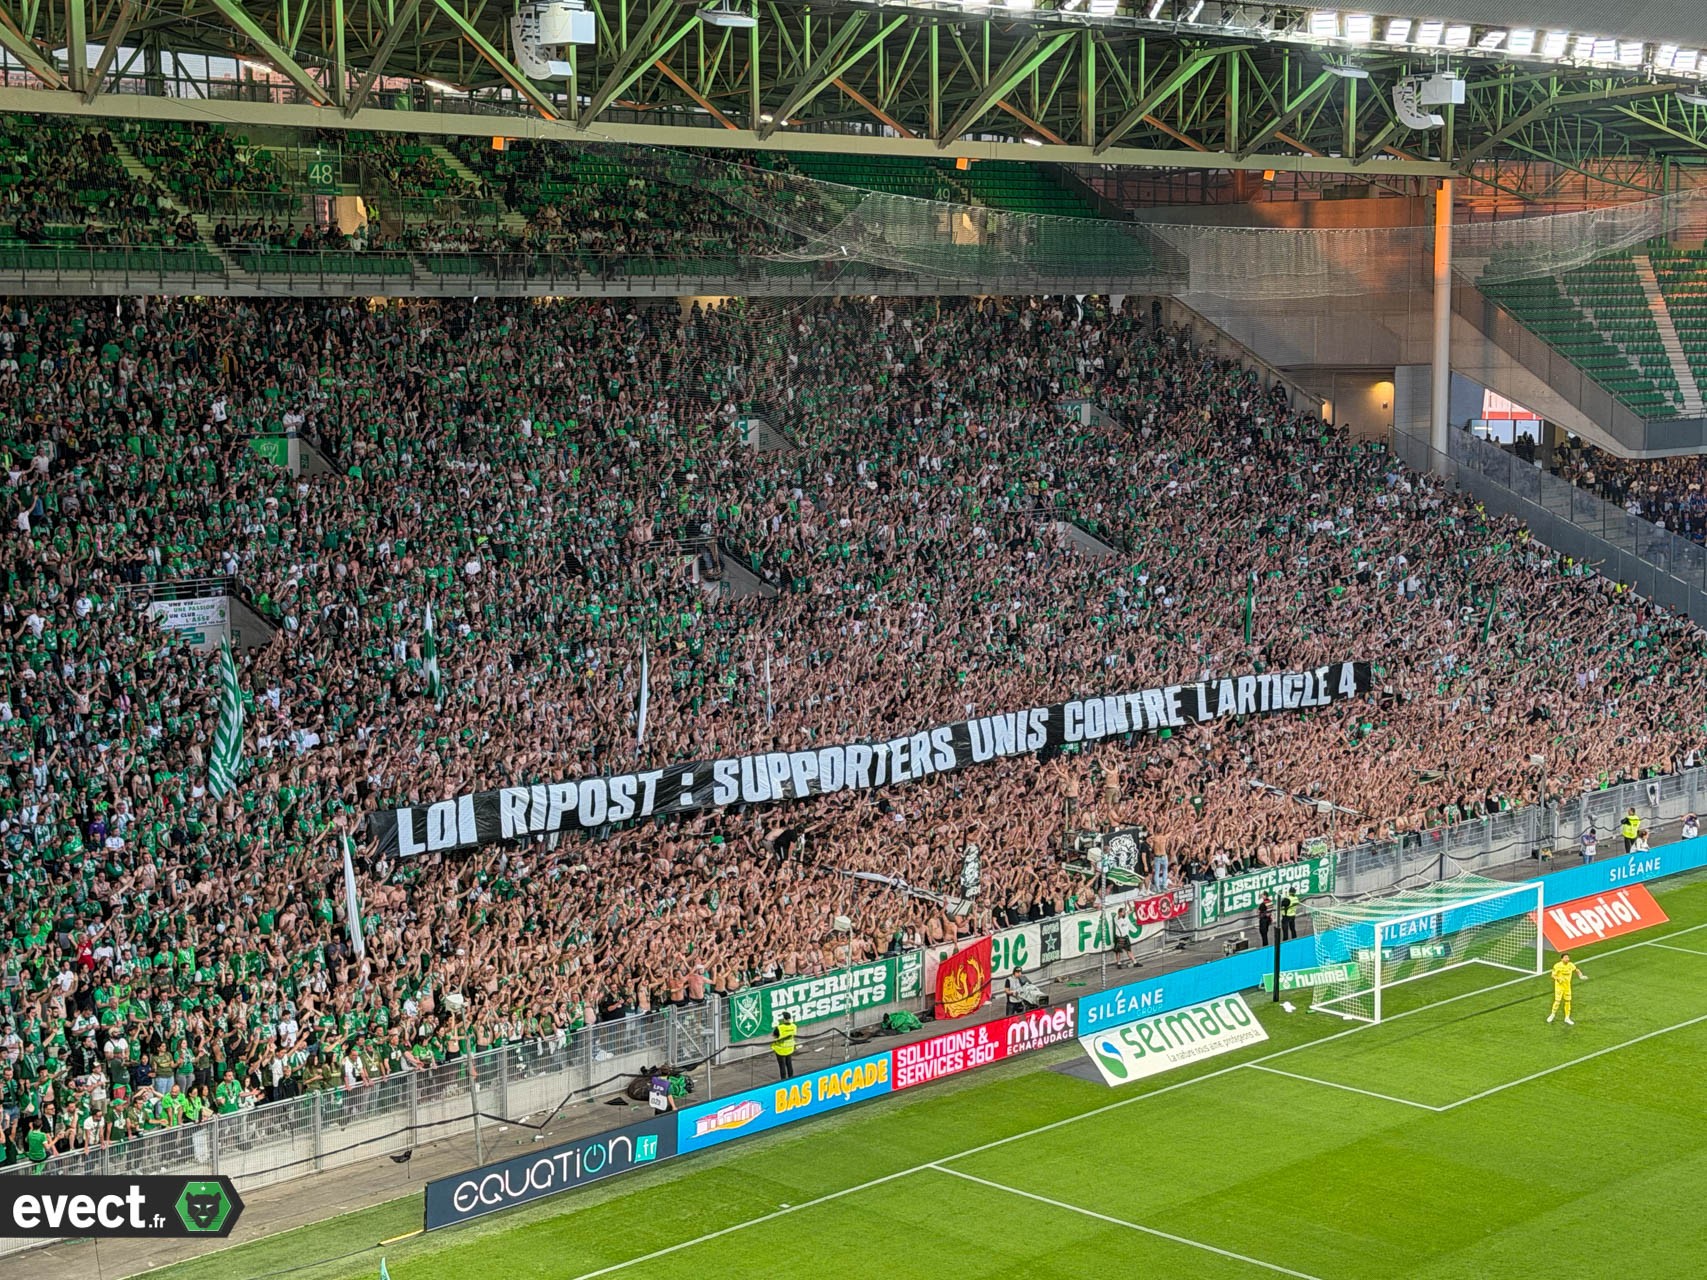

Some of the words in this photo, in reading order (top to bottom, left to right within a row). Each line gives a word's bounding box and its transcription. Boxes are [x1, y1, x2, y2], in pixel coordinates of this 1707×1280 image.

[310, 164, 333, 184] 48
[188, 604, 215, 612] PASSION
[396, 793, 478, 857] LOI
[499, 769, 663, 839] RIPOST
[680, 773, 694, 806] :
[712, 727, 957, 806] SUPPORTERS
[967, 707, 1049, 763] UNIS
[1063, 685, 1186, 742] CONTRE
[1196, 666, 1331, 722] L'ARTICLE
[1337, 662, 1357, 699] 4
[1223, 868, 1277, 896] LIBERTÉ
[1277, 863, 1311, 882] POUR
[1609, 856, 1662, 882] SILÉANE
[1223, 892, 1253, 913] LES
[1548, 890, 1641, 939] Kapriol
[1077, 907, 1143, 953] FAS
[1409, 945, 1444, 959] BKT
[770, 965, 887, 1008] INTERDITS
[1295, 966, 1348, 987] hummel
[771, 983, 887, 1028] PRÉSENTS
[1088, 988, 1164, 1023] SILÉANE
[897, 1028, 976, 1068] SOLUTIONS
[978, 1025, 989, 1044] &
[1006, 1028, 1075, 1056] ECHAFAUDAGE
[1119, 998, 1251, 1060] sermaco
[897, 1052, 964, 1087] SERVICES
[967, 1041, 999, 1067] 360°
[1176, 1048, 1196, 1061] nature
[775, 1080, 813, 1114] BAS
[817, 1058, 889, 1101] FAÇADE
